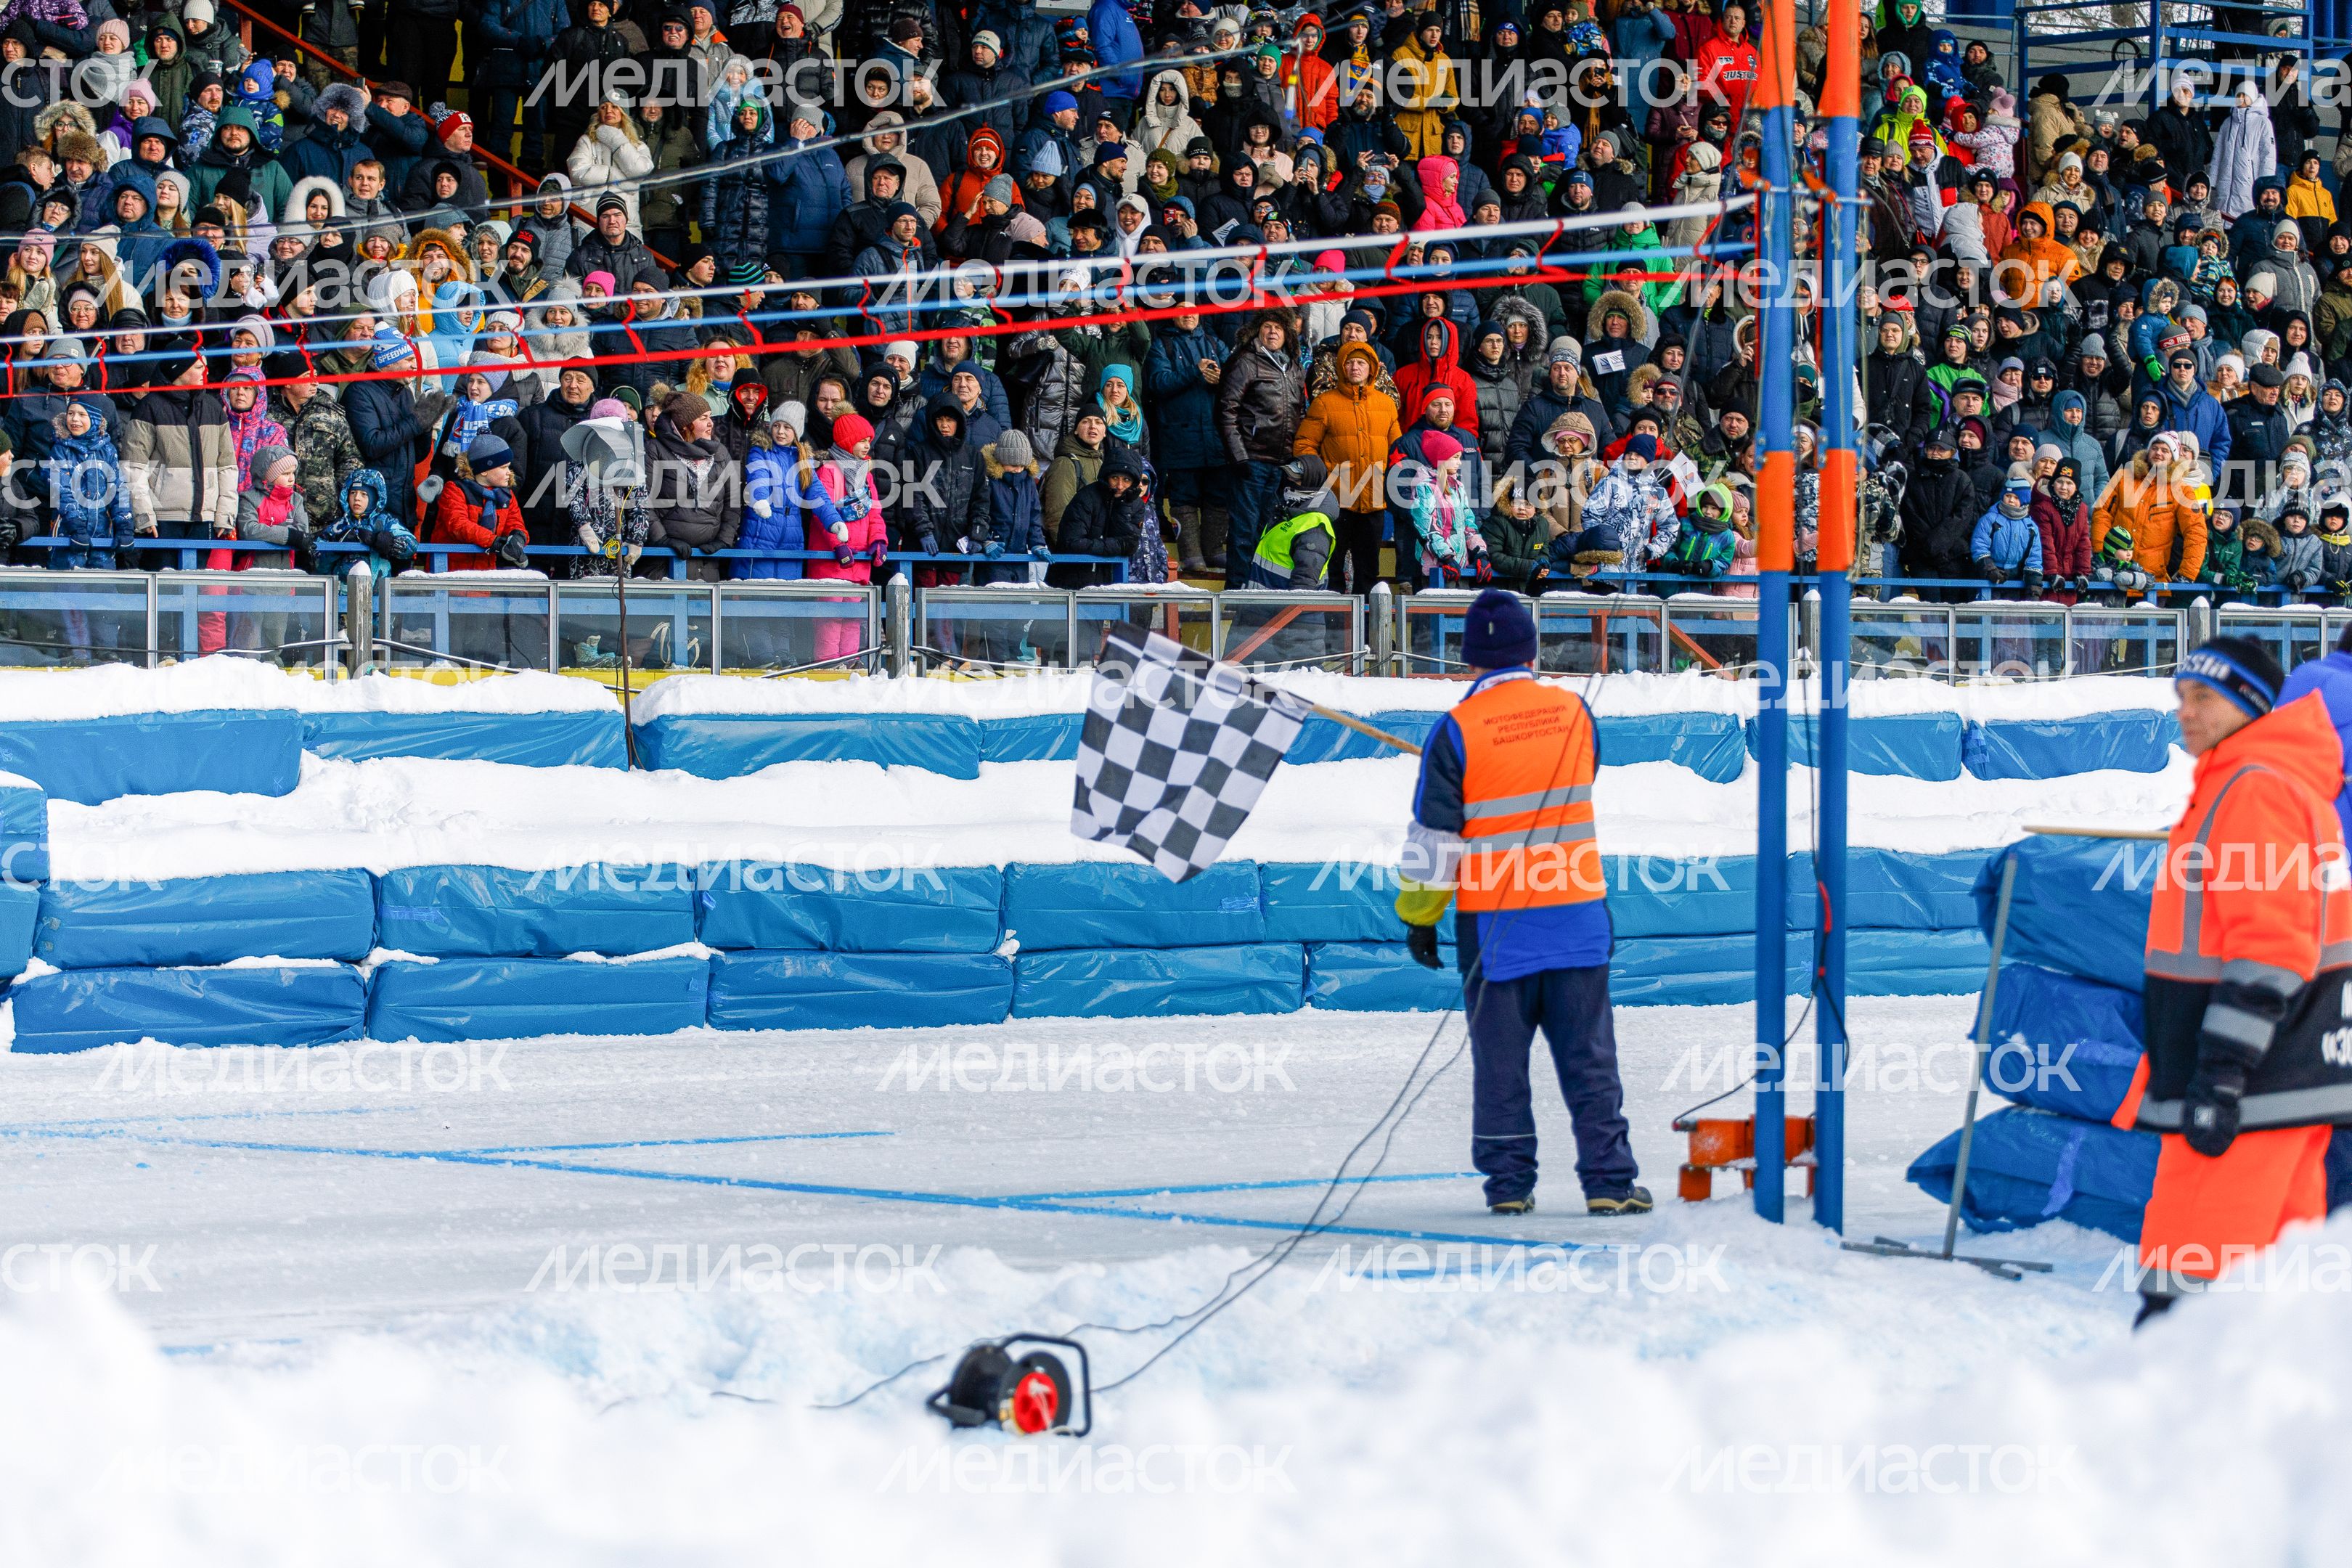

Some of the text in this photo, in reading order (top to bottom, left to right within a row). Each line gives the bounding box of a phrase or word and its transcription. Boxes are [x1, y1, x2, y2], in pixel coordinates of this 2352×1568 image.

[1482, 704, 1567, 726] МОТОФЕДЕРАЦИЯ
[1497, 716, 1560, 734] РЕСПУБЛИКИ
[1493, 726, 1569, 746] БАШКОРТОСТАН
